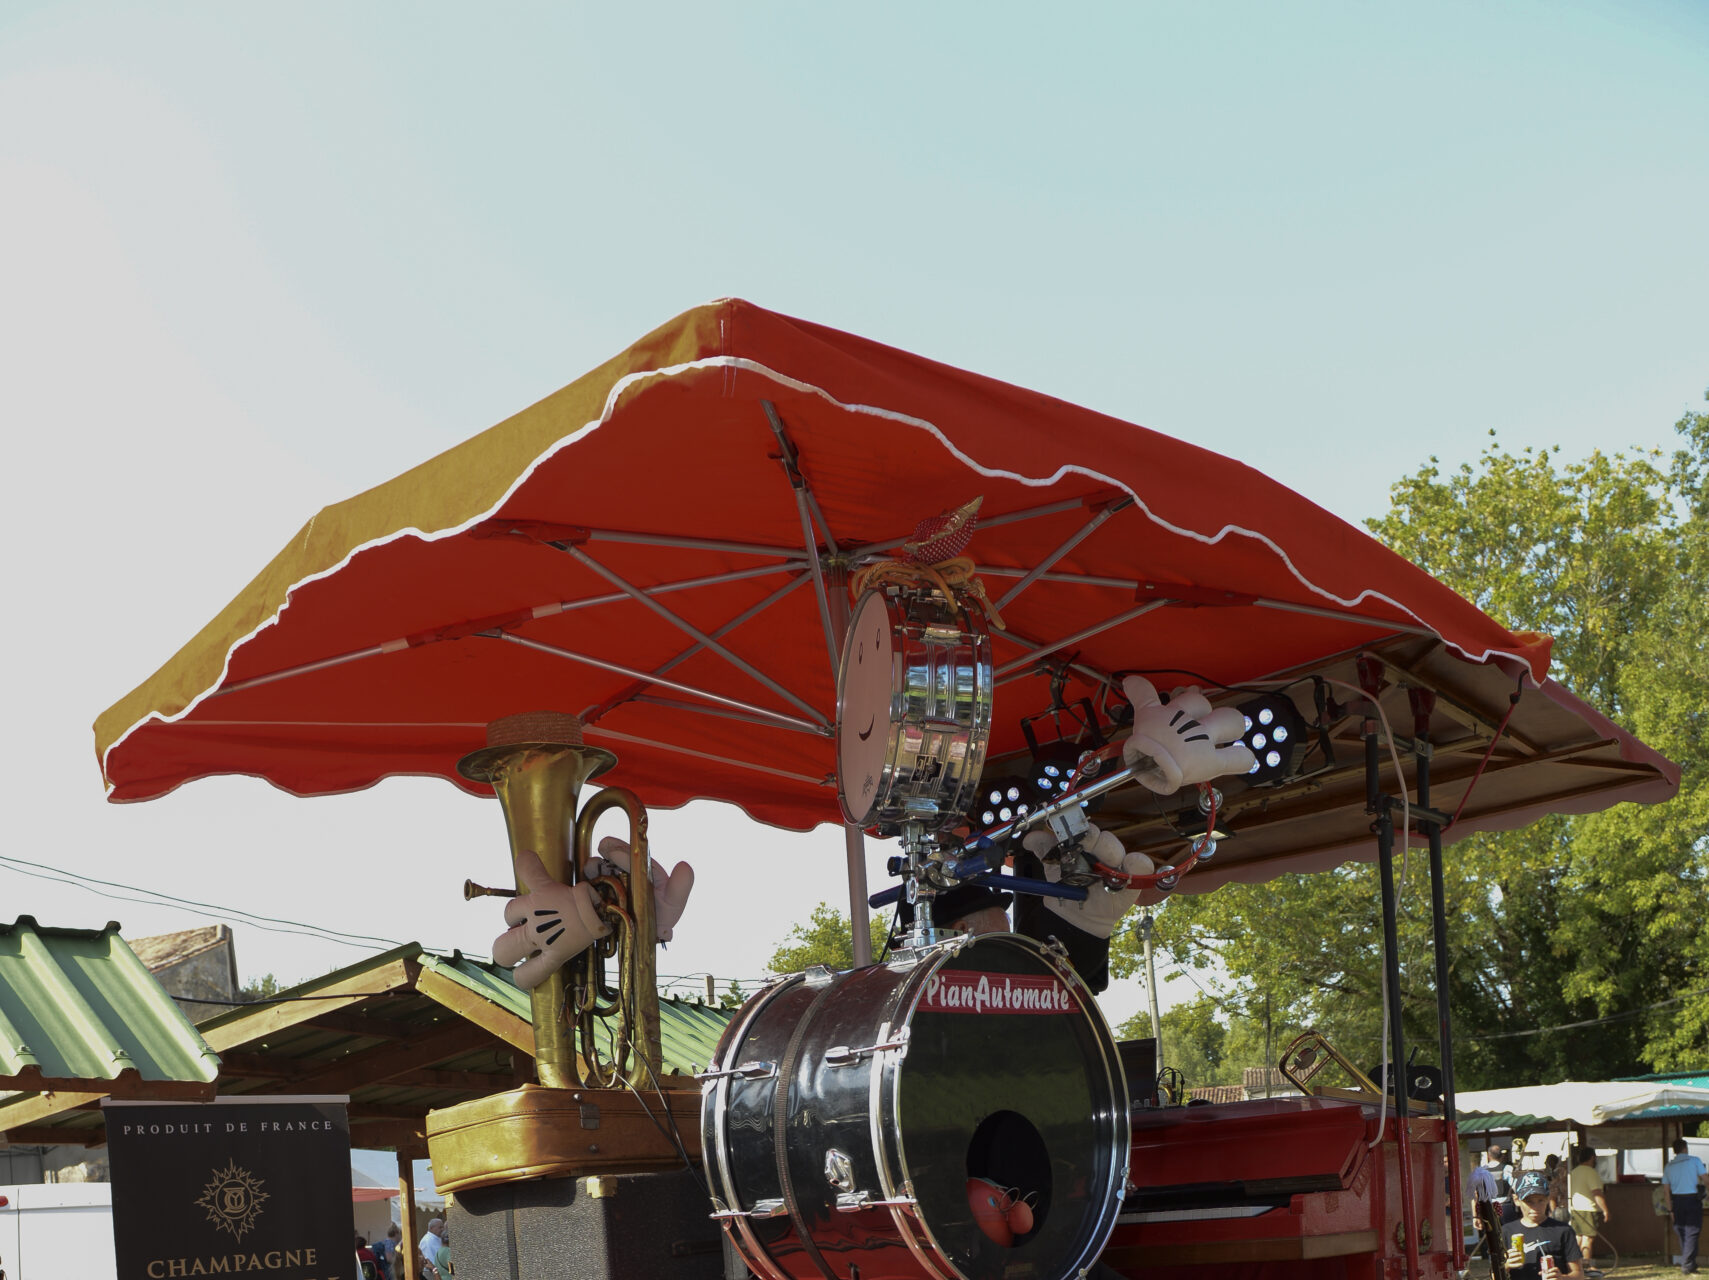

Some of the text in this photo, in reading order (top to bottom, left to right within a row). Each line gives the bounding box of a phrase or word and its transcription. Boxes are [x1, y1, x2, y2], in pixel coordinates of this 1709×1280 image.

[926, 973, 1069, 1013] PianAutomate
[124, 1121, 332, 1135] PRODUIT DE FRANCE
[147, 1248, 317, 1279] CHAMPAGNE
